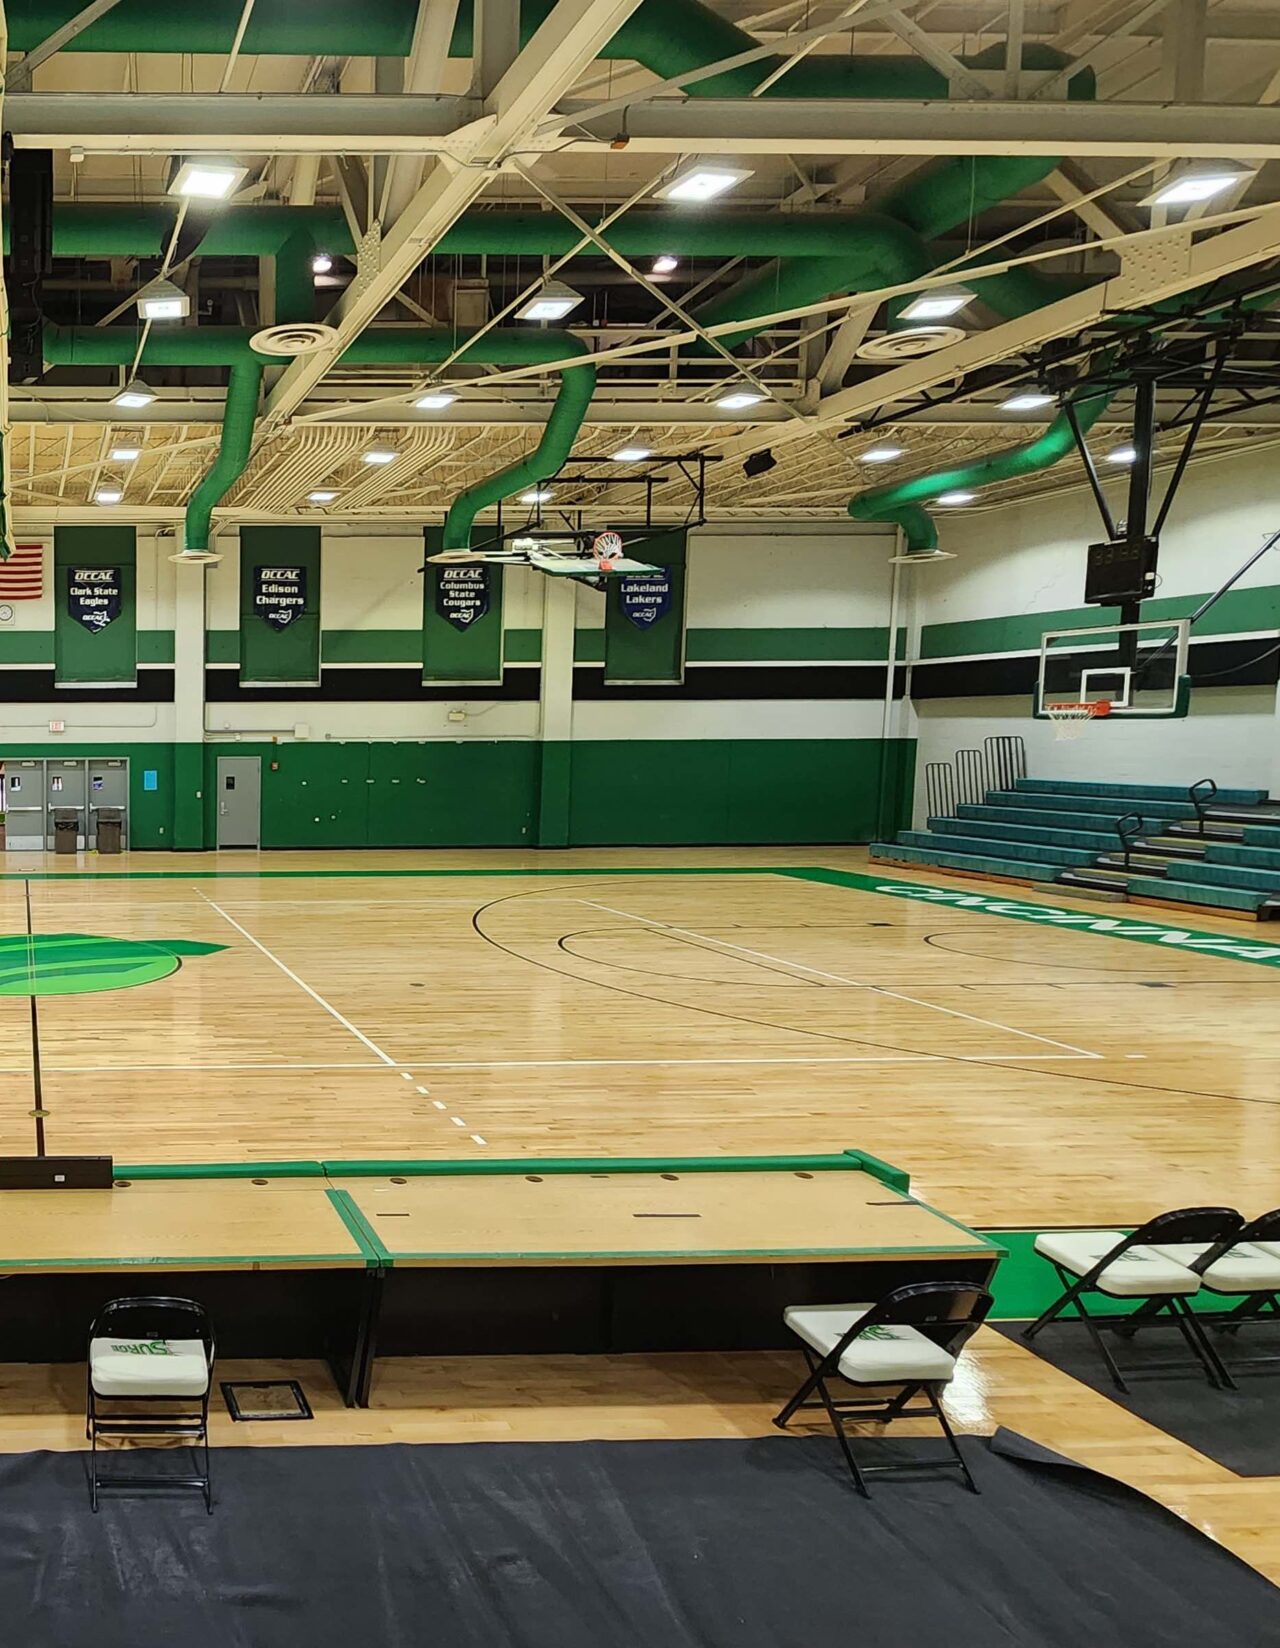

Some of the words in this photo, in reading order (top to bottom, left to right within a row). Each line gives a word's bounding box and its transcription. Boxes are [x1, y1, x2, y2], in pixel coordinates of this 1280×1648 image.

[74, 572, 115, 581] OCCAC
[261, 570, 300, 580] OCCAC
[443, 569, 483, 579] OCCAC
[262, 583, 299, 594] Edison
[440, 581, 485, 590] Columbus
[621, 583, 669, 593] Lakeland
[70, 587, 92, 596] Clark
[94, 587, 118, 596] State
[449, 590, 476, 598] State
[79, 597, 109, 607] Eagles
[255, 595, 304, 607] Chargers
[443, 598, 481, 608] Cougars
[625, 594, 663, 604] Lakers
[875, 885, 1280, 963] CINCINNA
